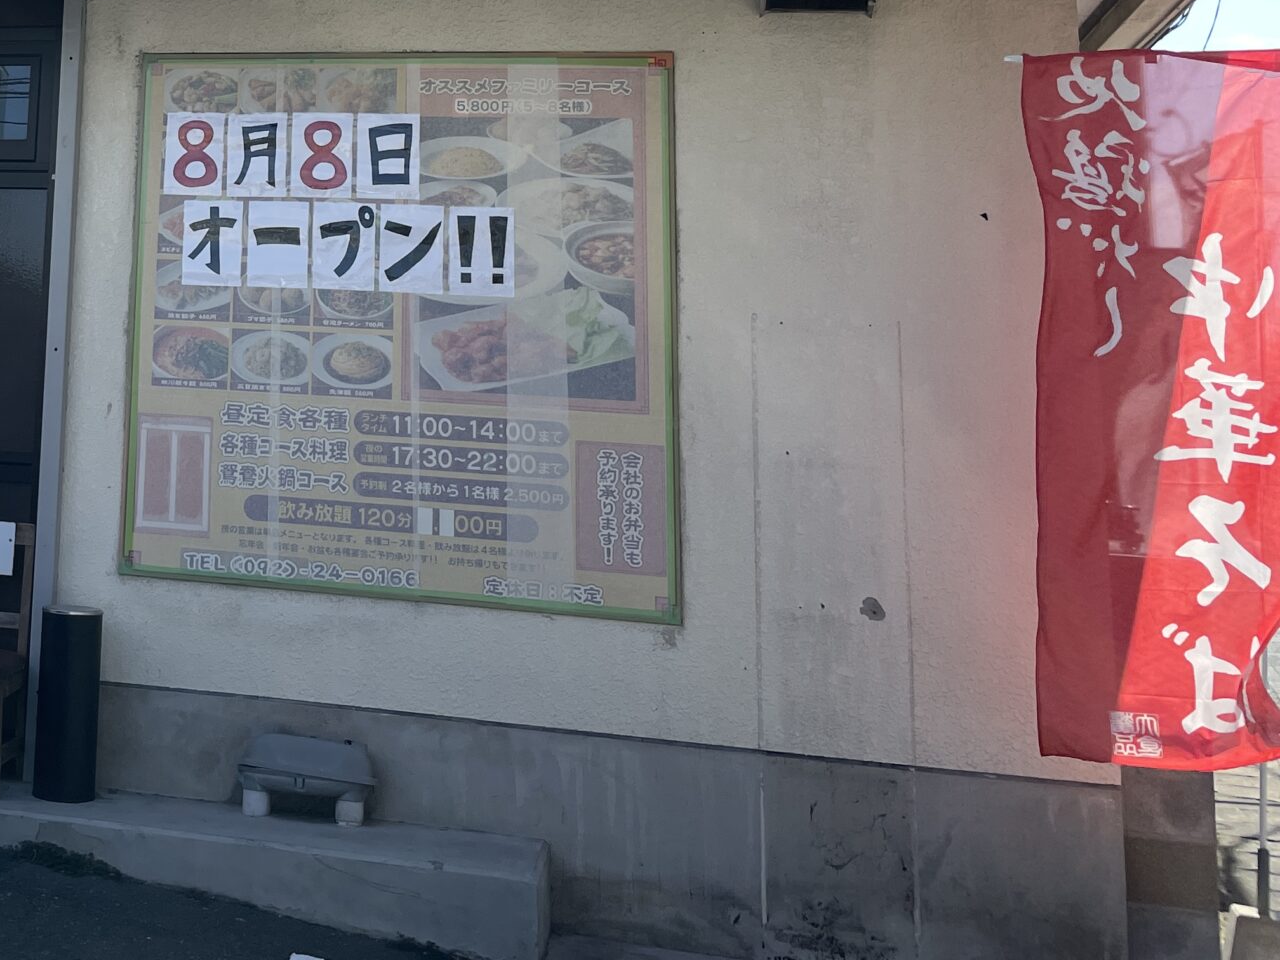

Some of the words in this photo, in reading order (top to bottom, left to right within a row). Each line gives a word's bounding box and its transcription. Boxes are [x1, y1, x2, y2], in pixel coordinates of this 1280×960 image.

[419, 79, 631, 95] オススメファミリーコース
[172, 118, 414, 189] 8月8日
[188, 205, 509, 285] オープン!!
[221, 402, 350, 432] 昼定食各種
[220, 432, 350, 464] 各種コース料理
[277, 500, 352, 525] 飲み放題
[597, 449, 619, 566] 予約承ります!
[621, 451, 643, 568] 会社のお弁当も
[184, 552, 227, 572] TEL
